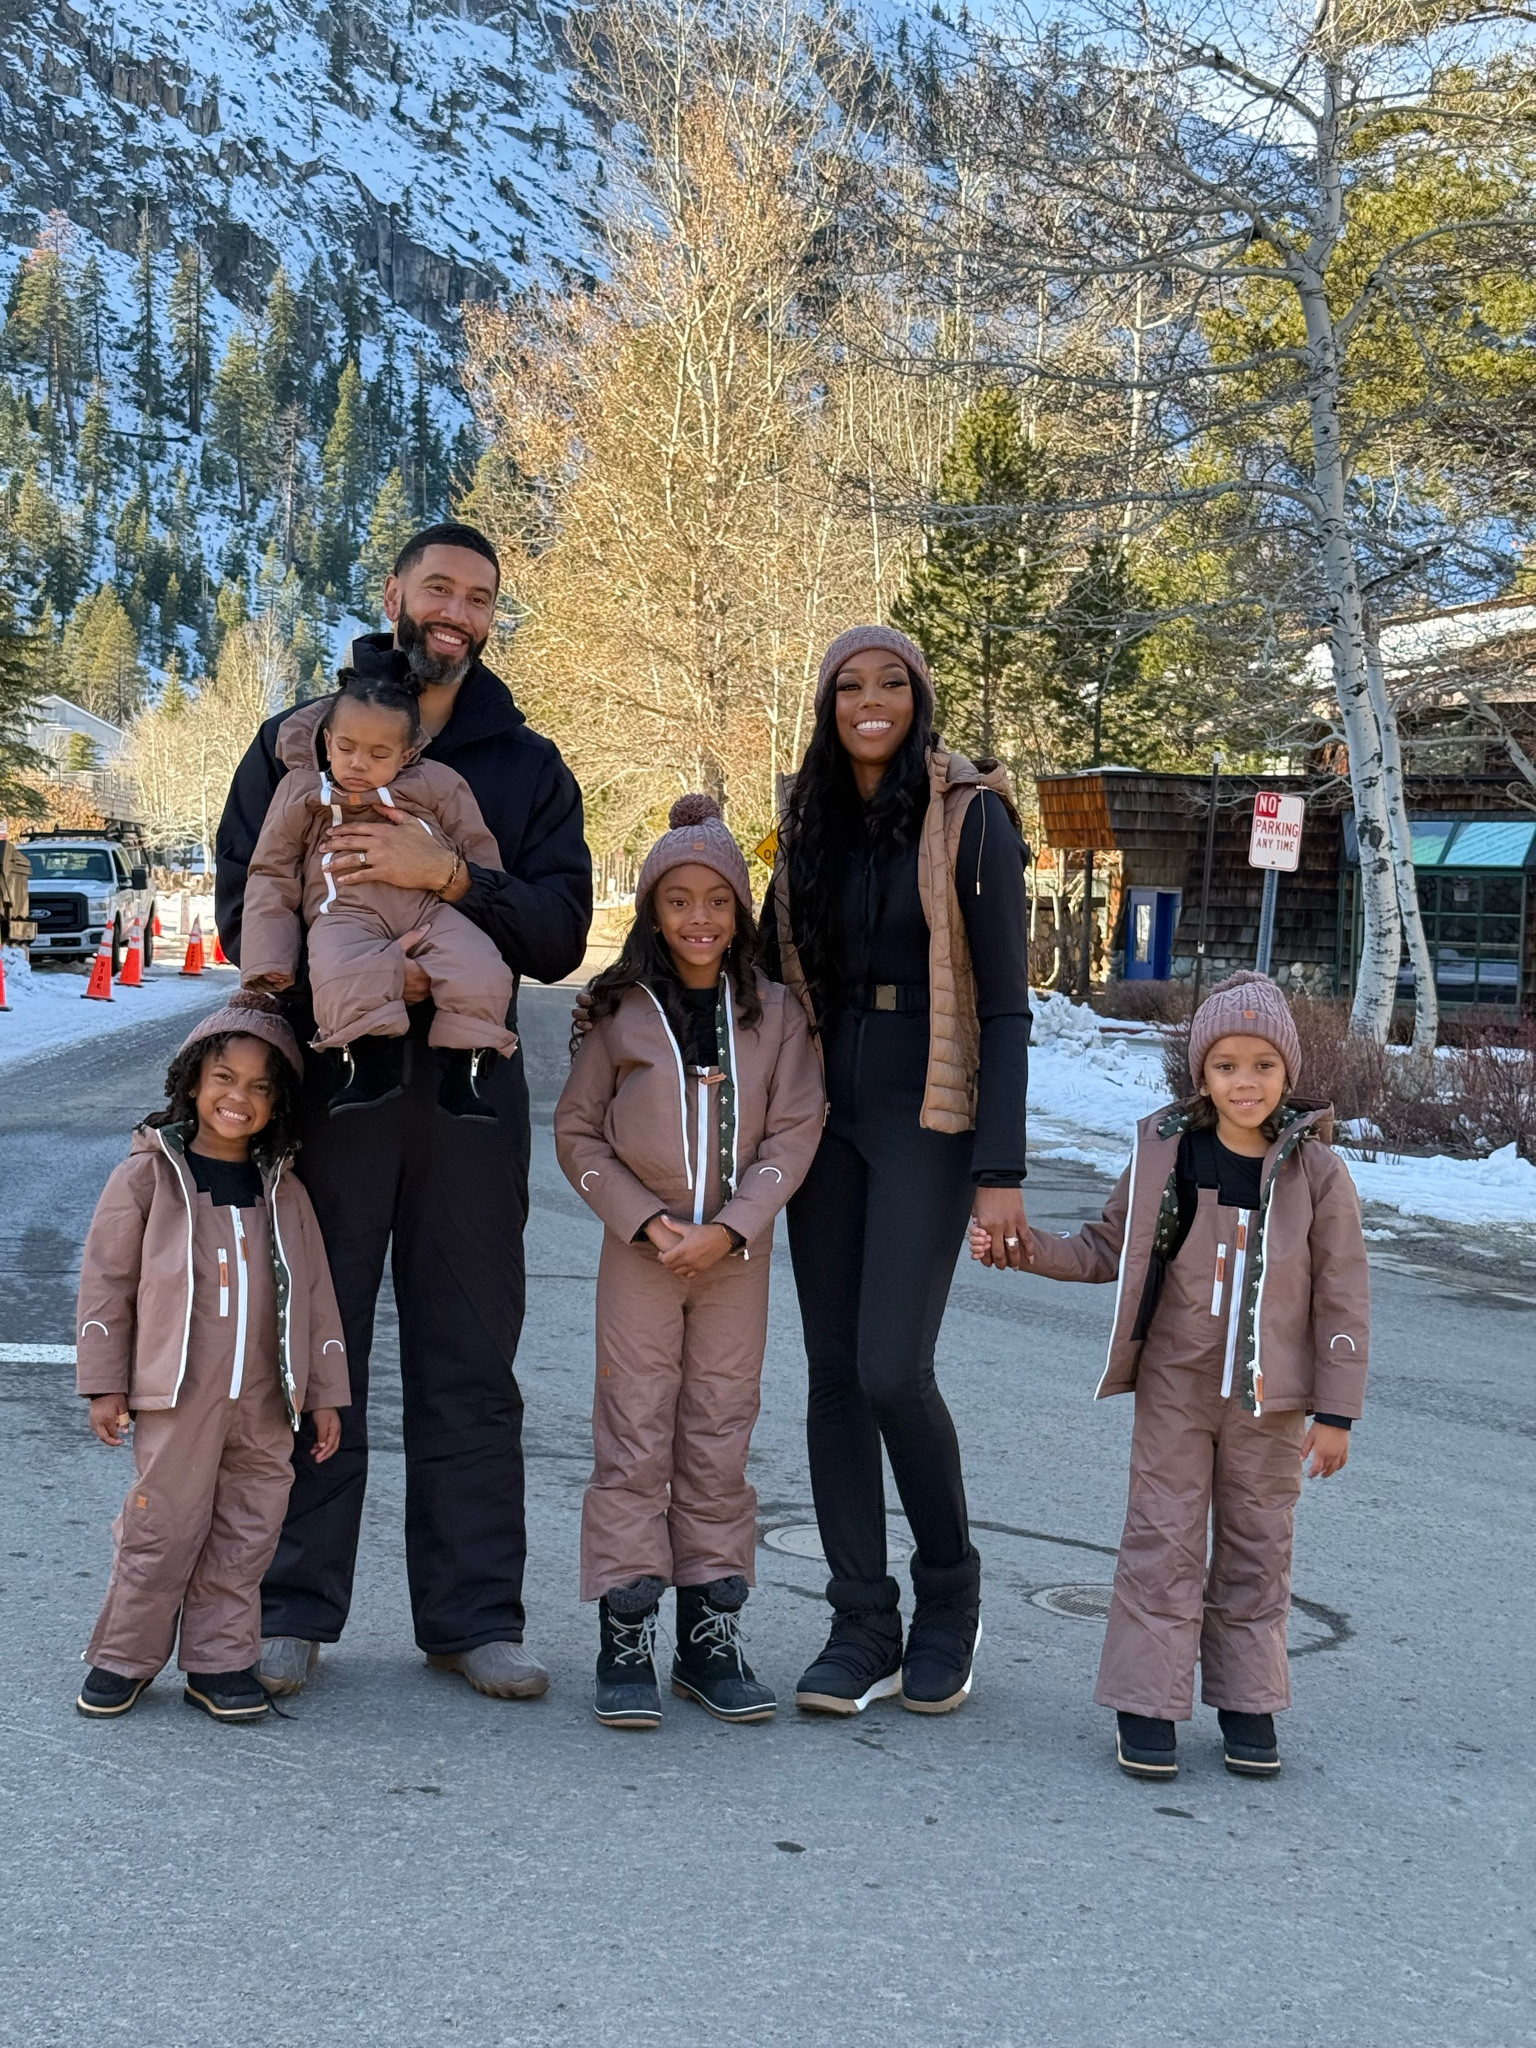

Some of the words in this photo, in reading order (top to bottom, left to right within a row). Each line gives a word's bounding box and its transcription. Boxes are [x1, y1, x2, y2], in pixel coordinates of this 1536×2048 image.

[1258, 795, 1277, 813] NO
[1255, 819, 1299, 837] PARKING
[1256, 838, 1273, 849] ANY
[1276, 840, 1294, 852] TIME
